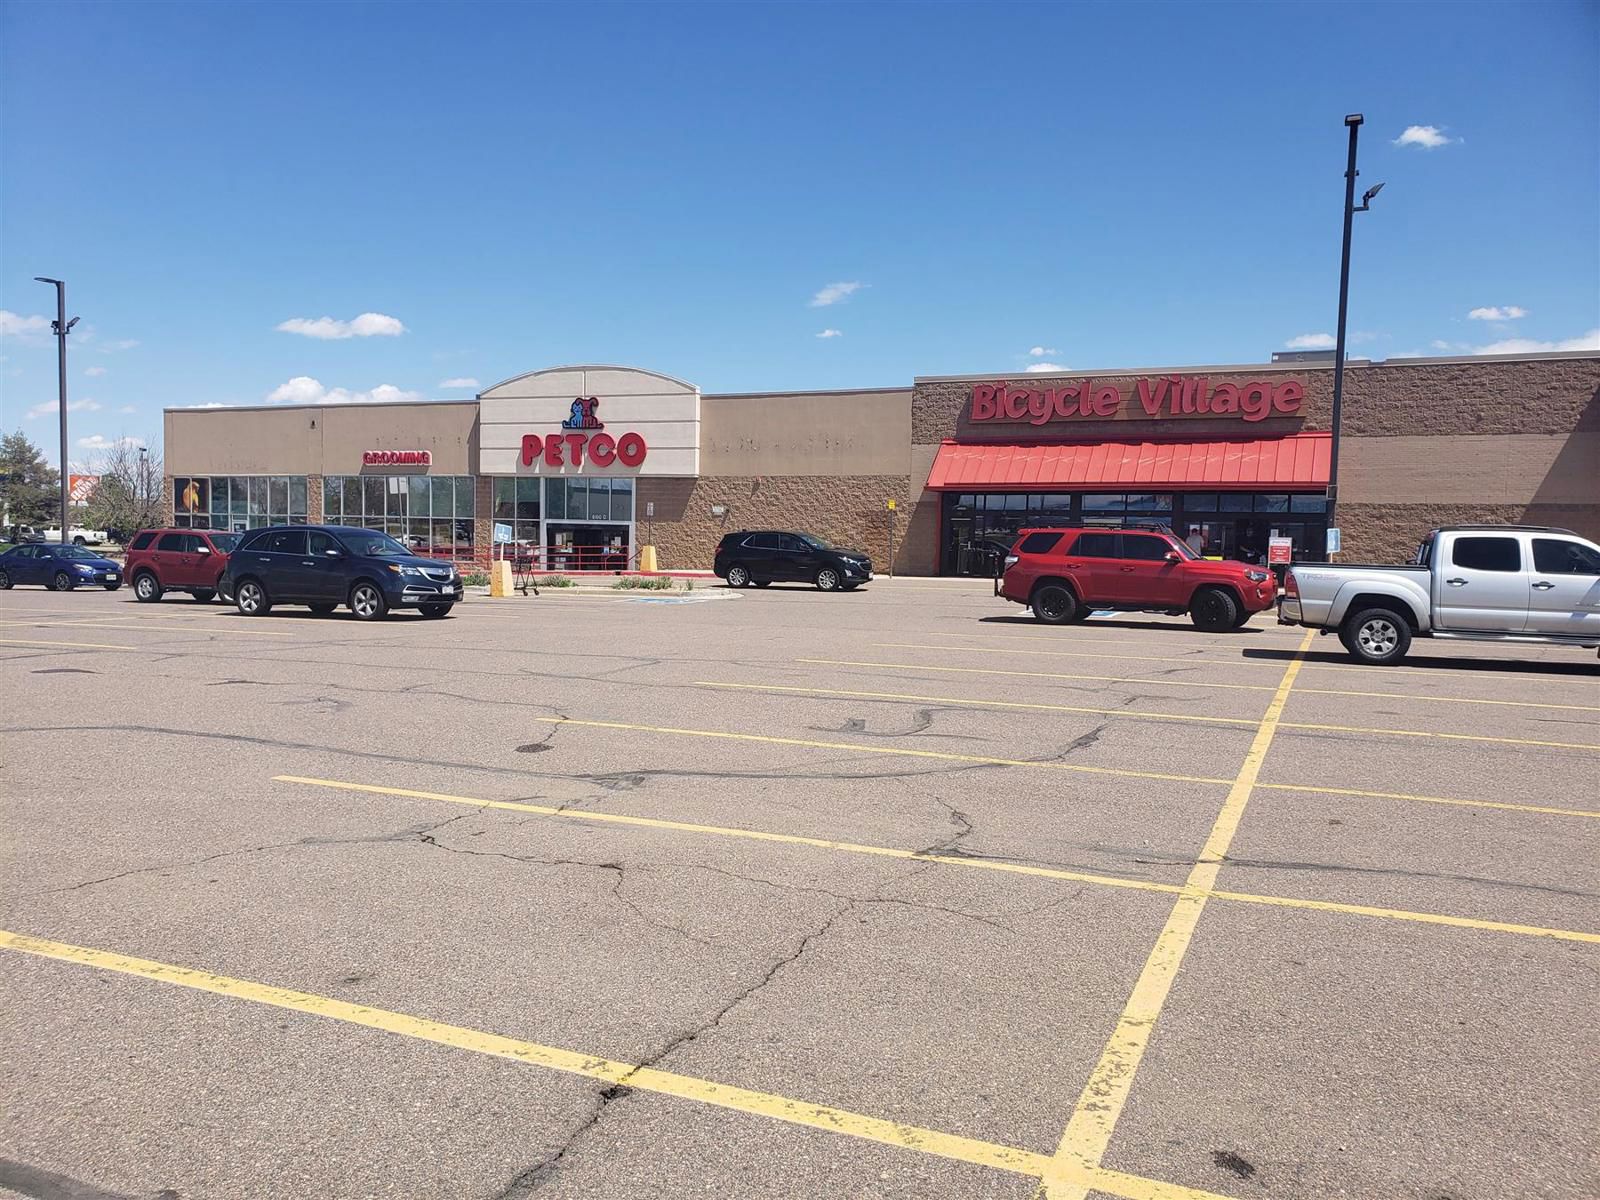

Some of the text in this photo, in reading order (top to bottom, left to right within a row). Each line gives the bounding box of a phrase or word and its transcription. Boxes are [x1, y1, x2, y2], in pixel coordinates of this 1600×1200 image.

[971, 373, 1304, 425] Bicycle Village
[363, 451, 432, 465] GROOMING
[522, 432, 647, 468] PETCO
